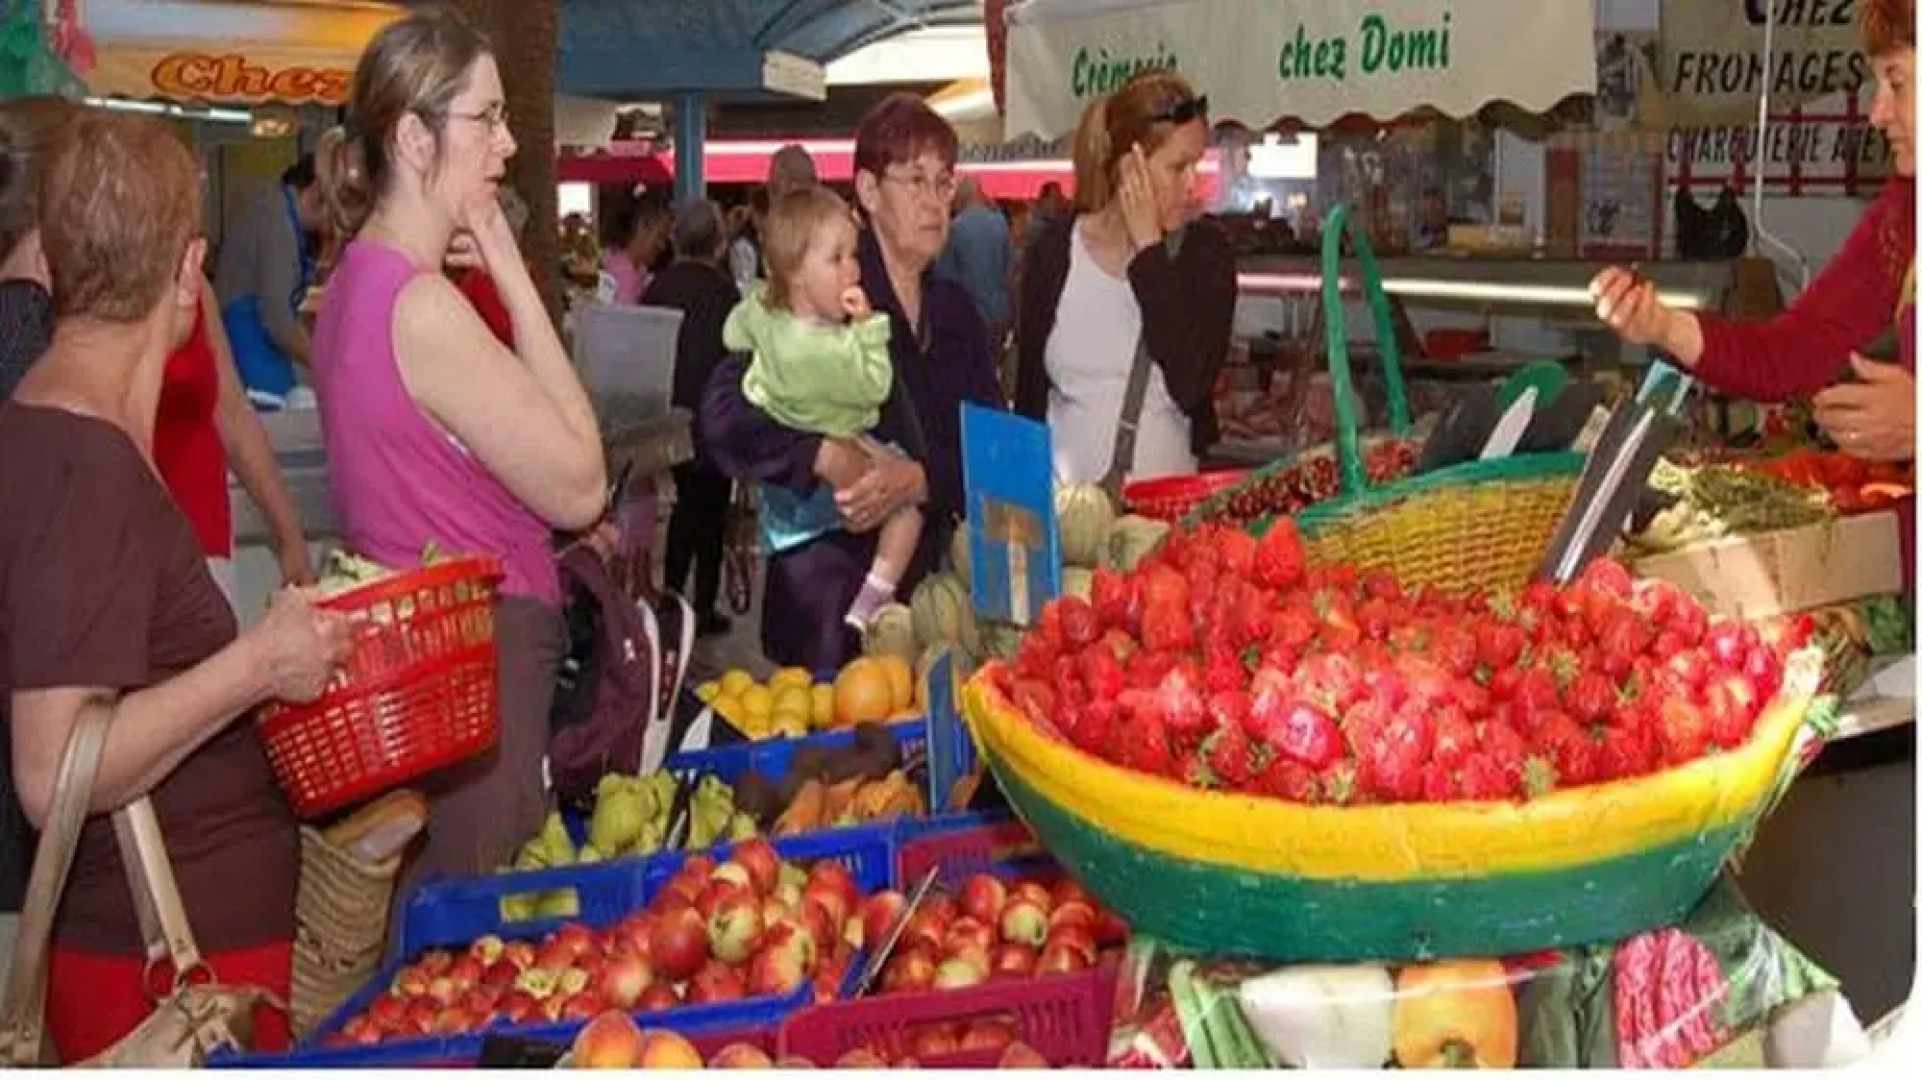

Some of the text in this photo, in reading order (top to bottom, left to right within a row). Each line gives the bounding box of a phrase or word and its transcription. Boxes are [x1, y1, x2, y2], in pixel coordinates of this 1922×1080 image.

[1279, 23, 1346, 80] chez
[1360, 13, 1451, 73] Domi
[152, 52, 349, 97] Chez
[1673, 52, 1865, 93] FROMAGES
